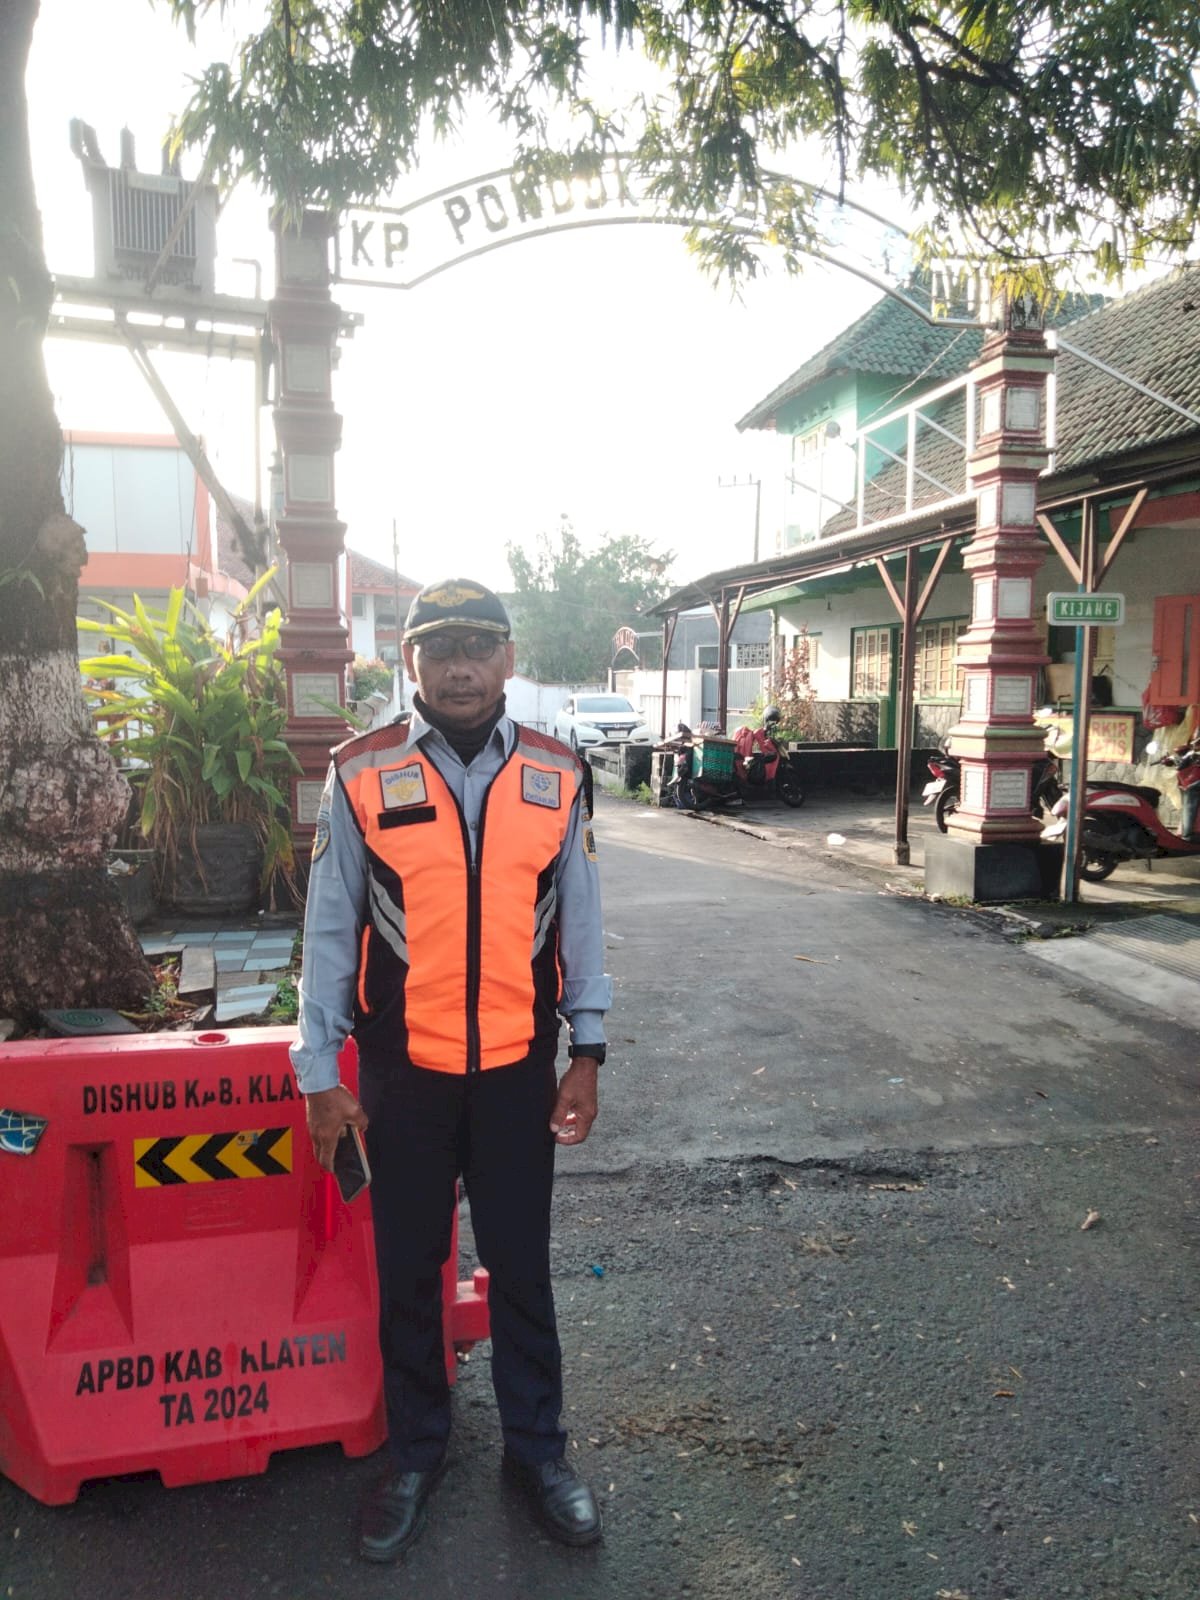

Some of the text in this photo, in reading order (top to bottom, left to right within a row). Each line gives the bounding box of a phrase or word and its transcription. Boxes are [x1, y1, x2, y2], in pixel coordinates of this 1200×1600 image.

[1060, 601, 1112, 616] KIJANG
[1091, 720, 1127, 738] RKIR
[1088, 739, 1126, 756] ATIS
[83, 1082, 177, 1115] DISHUB
[248, 1071, 303, 1102] KLA
[76, 1355, 154, 1395] APBD
[164, 1347, 222, 1384] KAB
[159, 1381, 269, 1428] TA 2024
